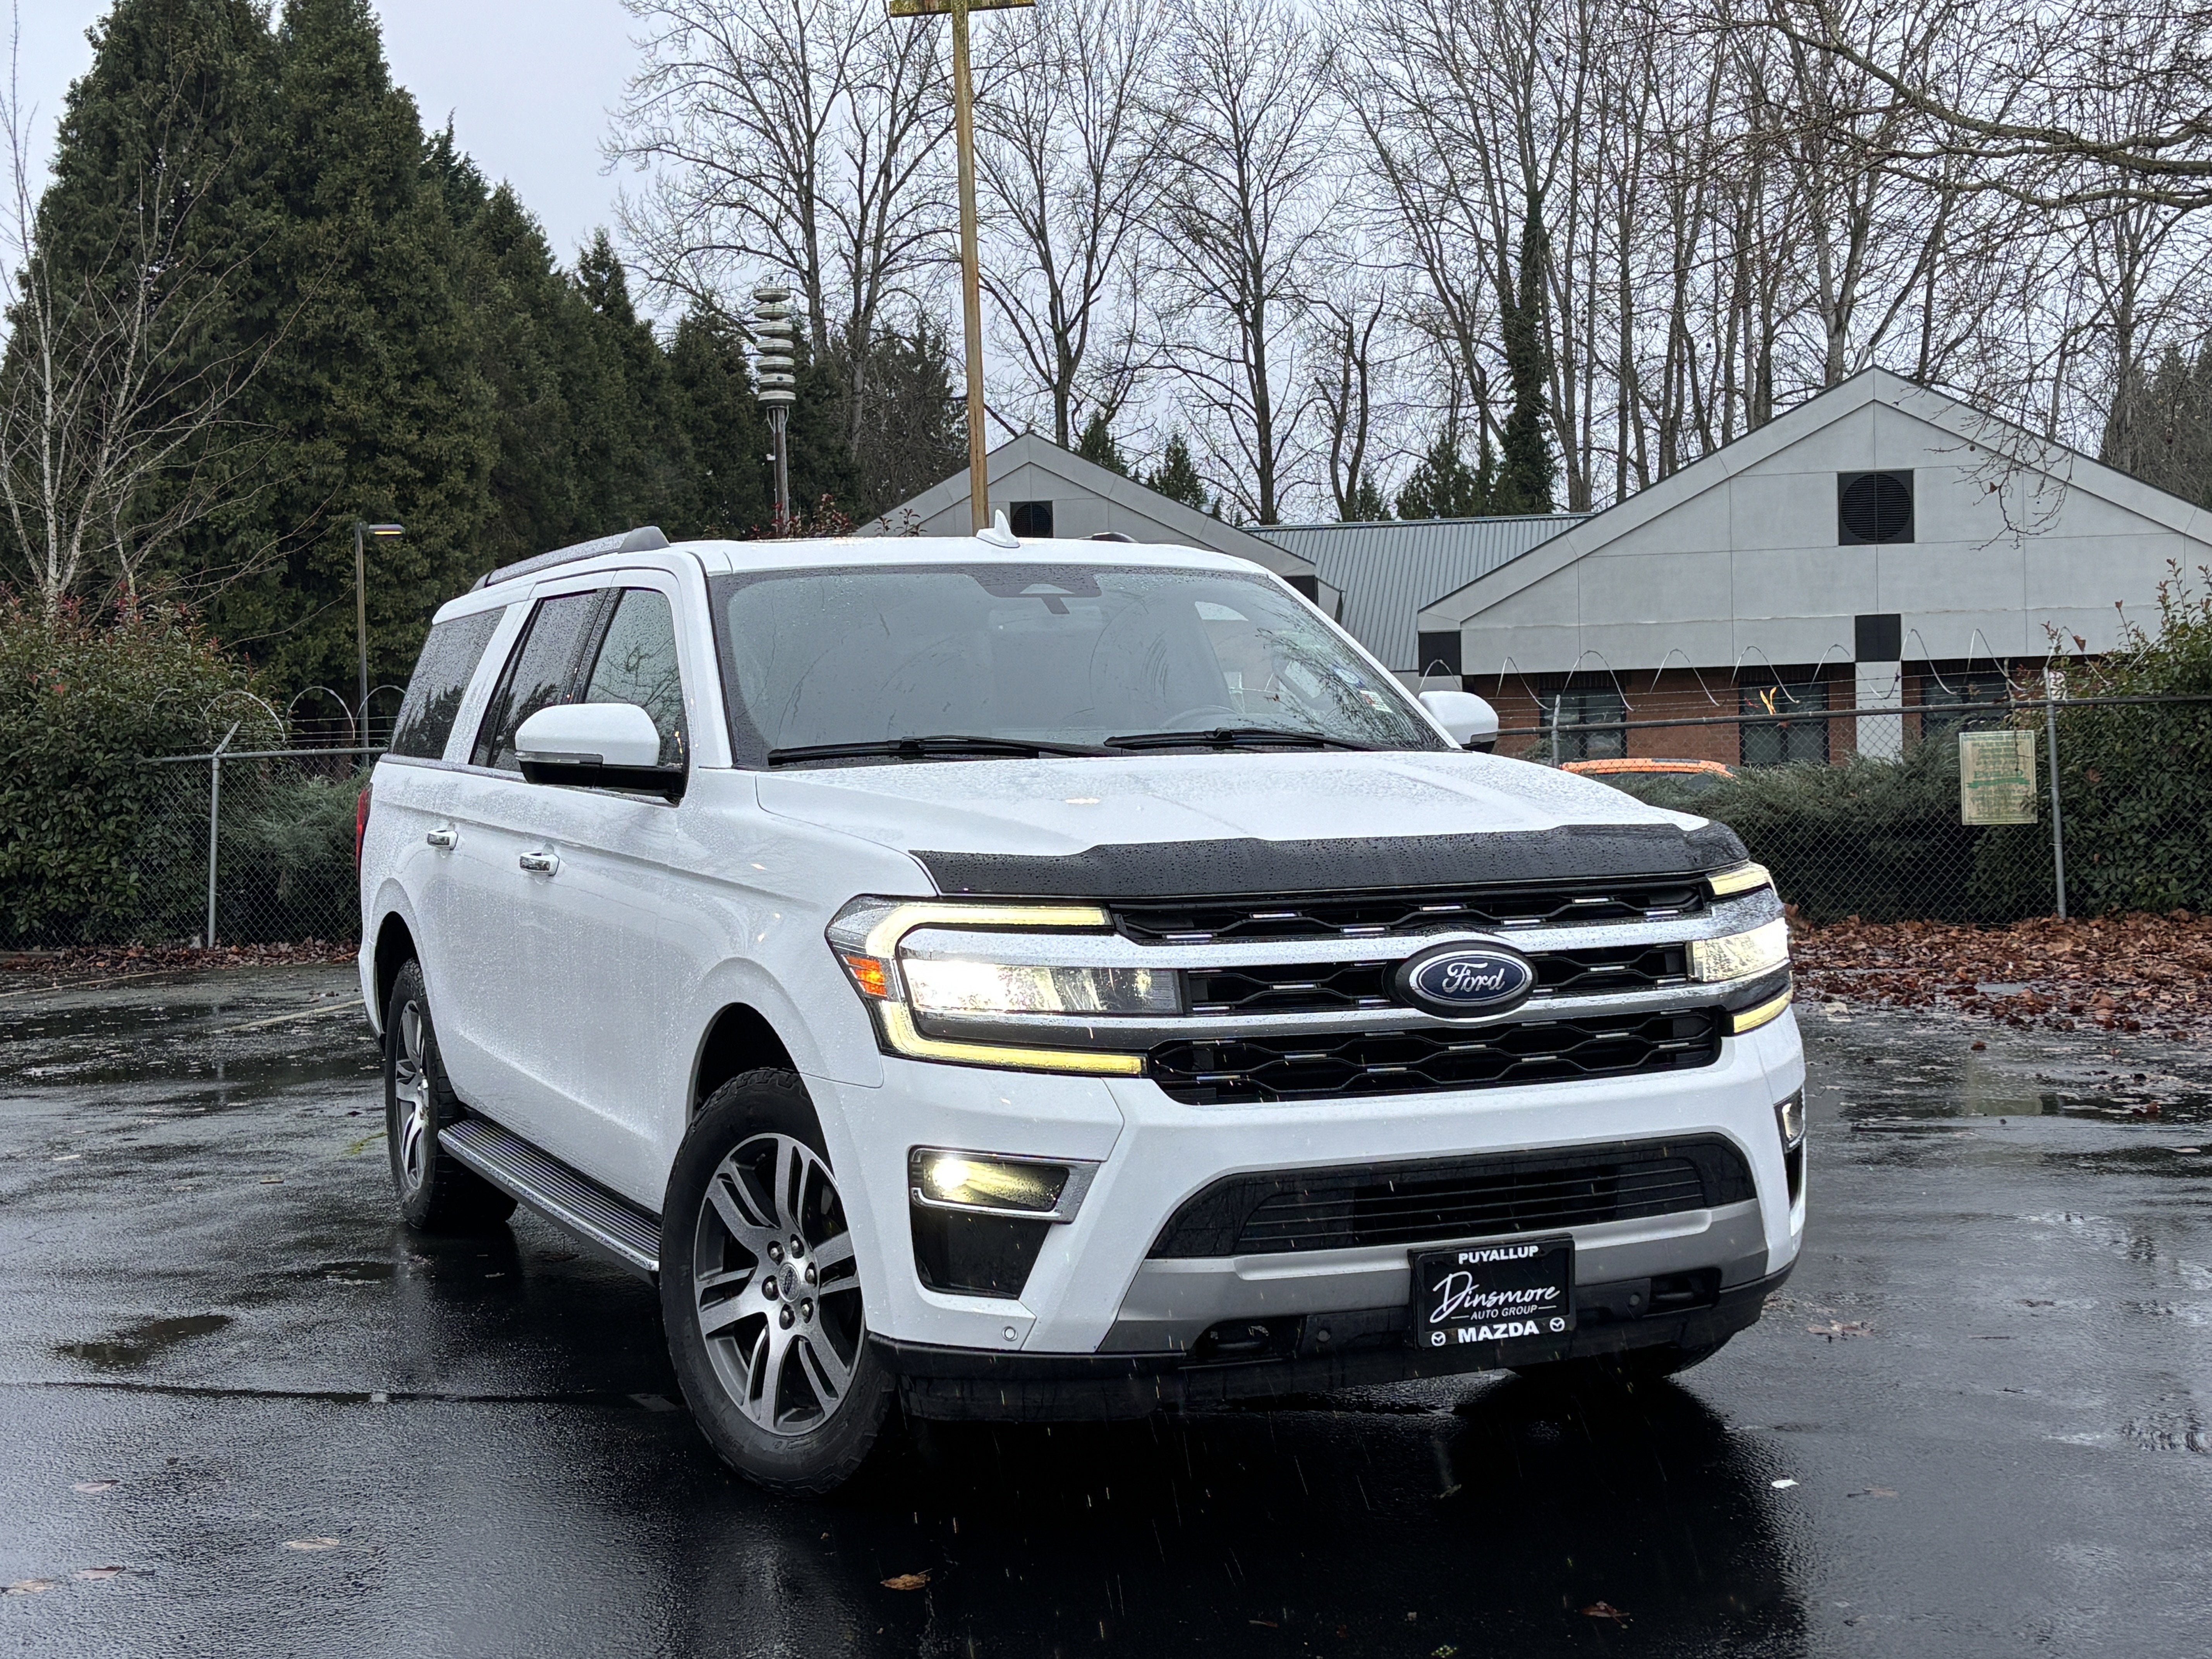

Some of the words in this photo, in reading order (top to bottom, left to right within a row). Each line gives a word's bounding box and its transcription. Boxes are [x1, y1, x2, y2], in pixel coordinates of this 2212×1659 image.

[1442, 962, 1505, 993] Ford
[1458, 1245, 1539, 1264] PUYALLUP
[1429, 1271, 1560, 1323] Dinsmore
[1470, 1309, 1499, 1320] AUTO
[1502, 1304, 1537, 1317] GROUP
[1458, 1320, 1539, 1343] MAZDA
